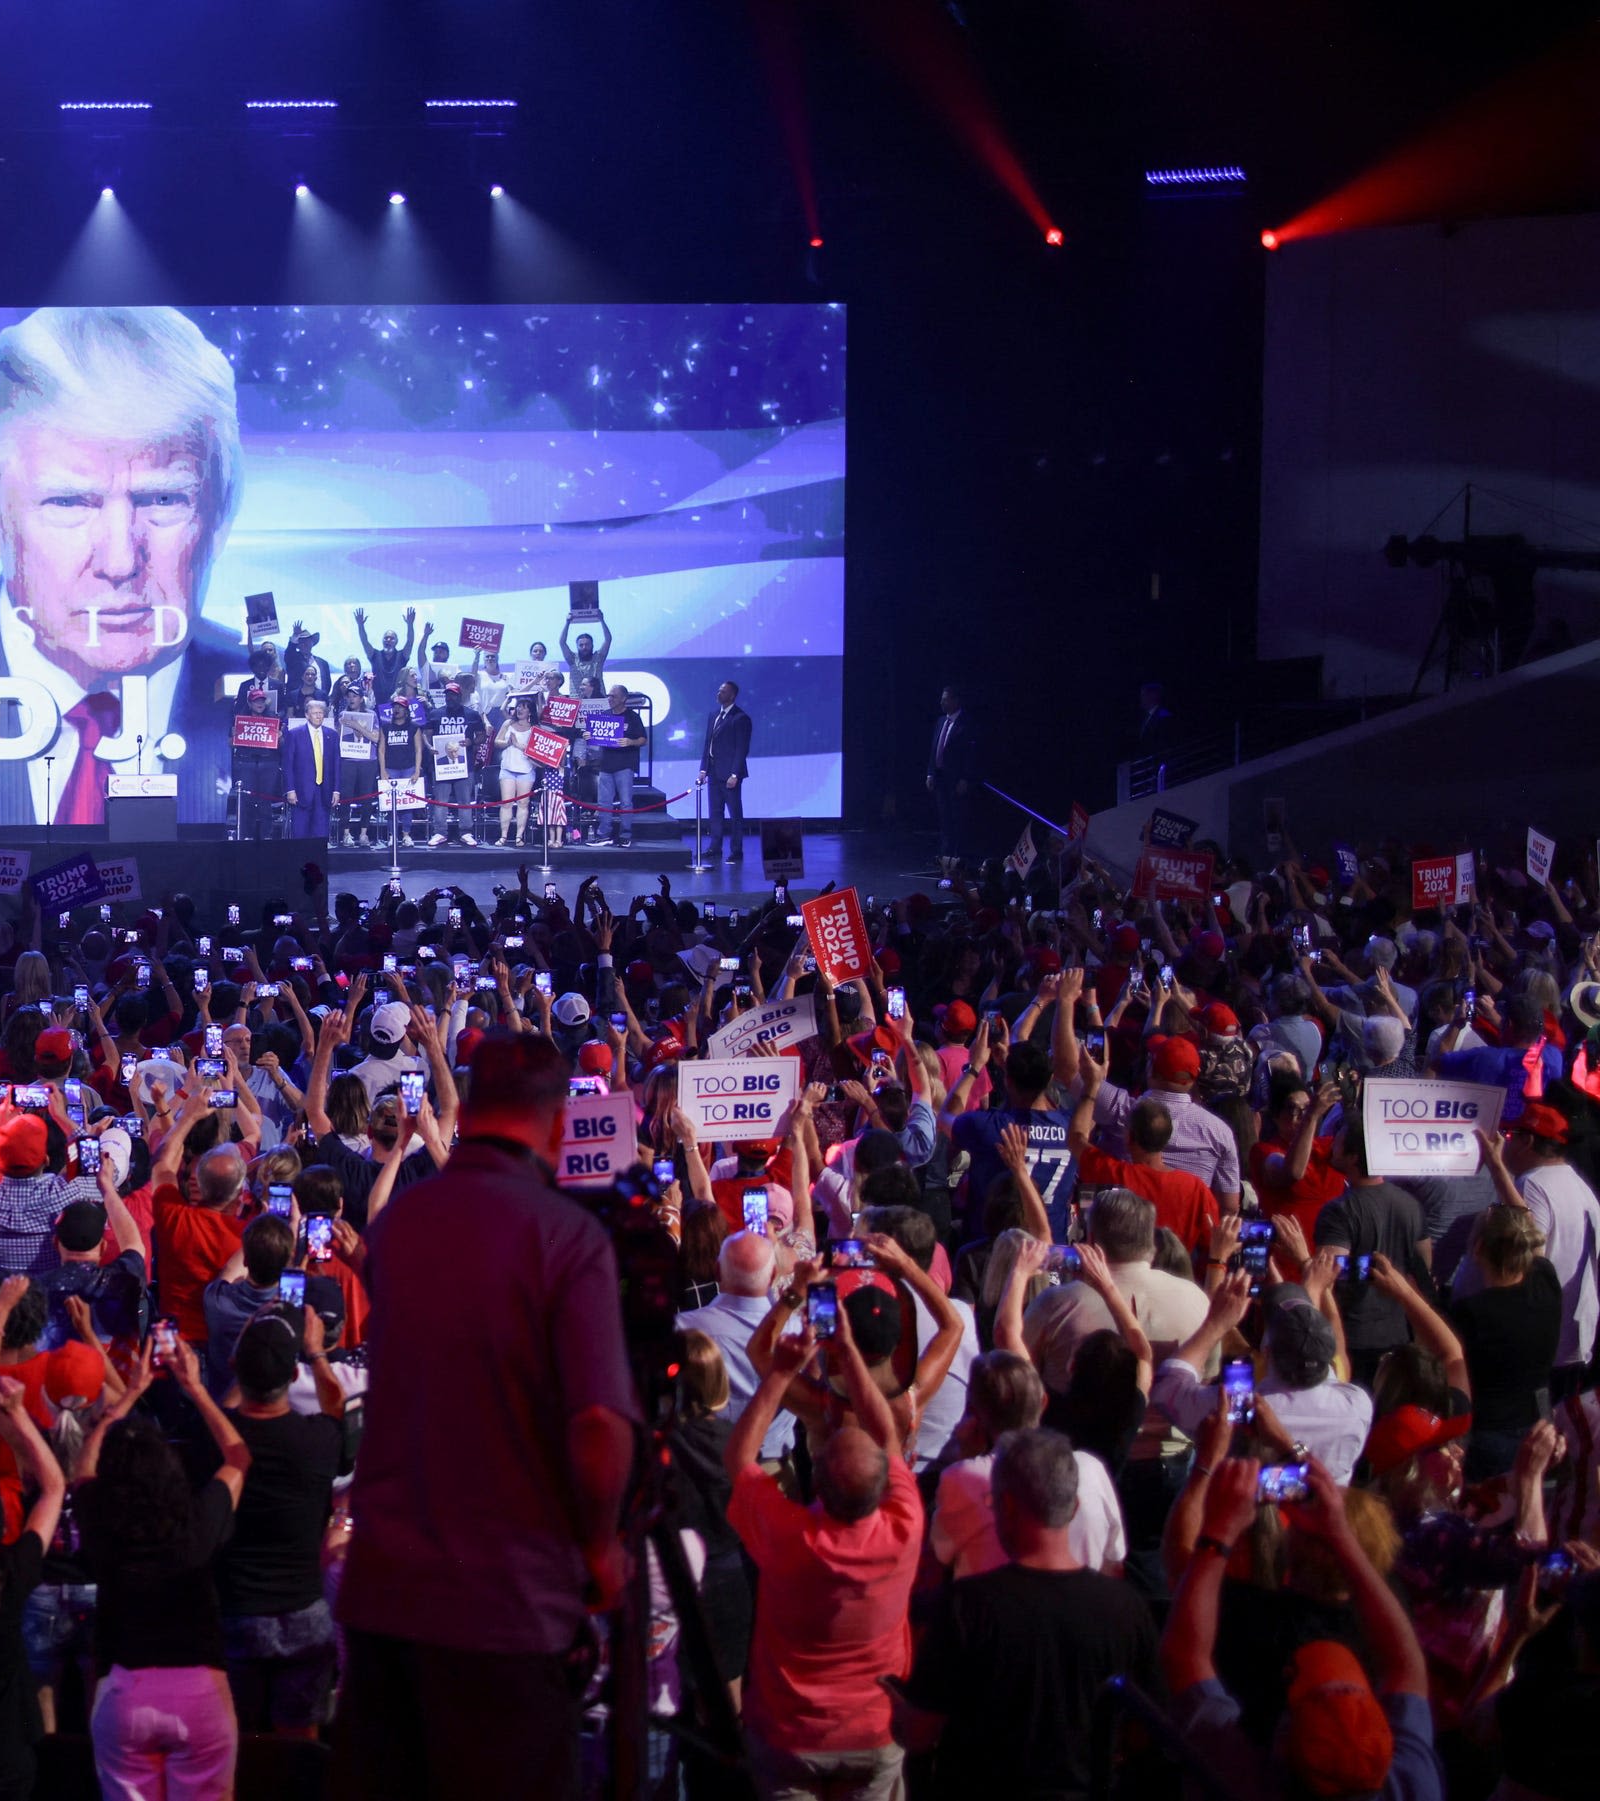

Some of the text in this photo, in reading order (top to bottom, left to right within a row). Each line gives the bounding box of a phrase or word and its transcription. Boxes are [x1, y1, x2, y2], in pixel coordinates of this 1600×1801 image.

[465, 623, 499, 636] TRUMP
[468, 632, 493, 643] 2024
[549, 701, 577, 711] TRUMP
[549, 709, 571, 718] 2024
[440, 717, 465, 725] DAD
[590, 720, 620, 730] TRUMP
[243, 725, 270, 734] 2024
[439, 725, 467, 734] ARMY
[592, 728, 615, 737] 2024
[238, 732, 274, 743] TRUMP
[387, 736, 409, 744] ARMY
[533, 732, 562, 750] TRUMP
[534, 742, 555, 756] 2024
[1153, 815, 1191, 832] TRUMP
[1153, 826, 1180, 840] 2024
[101, 866, 125, 877] OTE
[1150, 856, 1207, 874] TRUMP
[36, 864, 89, 893] TRUMP
[1155, 870, 1196, 885] 2024
[1416, 866, 1452, 881] TRUMP
[47, 877, 88, 901] 2024
[1423, 881, 1449, 893] 2024
[815, 926, 825, 948] TRUMP
[820, 914, 844, 965] 2024
[832, 898, 861, 970] TRUMP
[720, 1006, 797, 1047] TOO BIG
[730, 1022, 791, 1055] TO RIG
[692, 1074, 780, 1094] TOO BIG
[700, 1102, 771, 1121] TO RIG
[1379, 1099, 1478, 1119] TOO BIG
[573, 1116, 616, 1138] BIG
[1389, 1132, 1466, 1151] TO RIG
[566, 1152, 609, 1175] RIG
